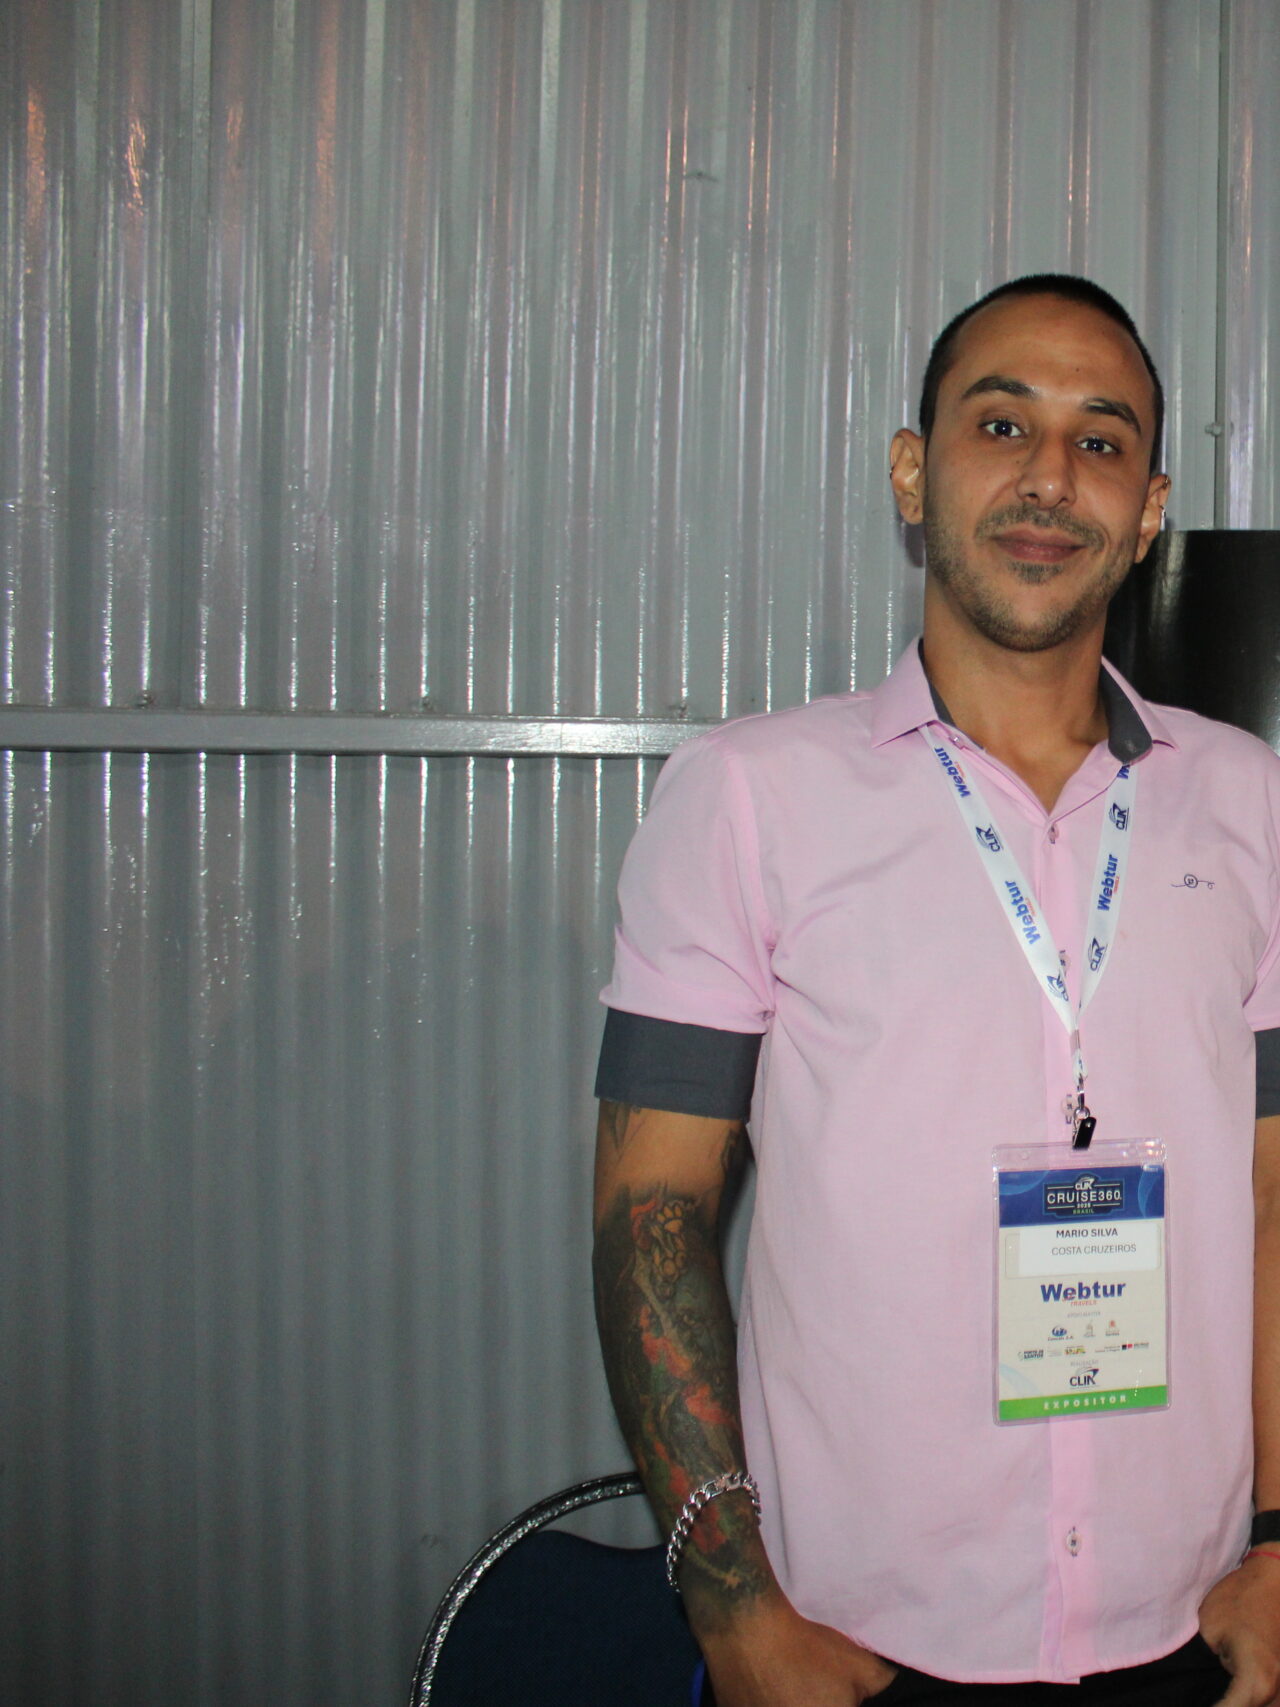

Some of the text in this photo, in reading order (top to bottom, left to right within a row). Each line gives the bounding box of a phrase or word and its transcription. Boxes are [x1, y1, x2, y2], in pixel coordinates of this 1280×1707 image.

[934, 747, 971, 798] Webtur
[1097, 853, 1119, 912] Webtur
[1005, 880, 1041, 945] Webtur
[1047, 1189, 1121, 1204] CRUISE360
[1056, 1227, 1118, 1239] MARIO SILVA
[1051, 1243, 1137, 1256] COSTA CRUZEIROS
[1040, 1281, 1126, 1303] Webtur
[1043, 1395, 1127, 1410] EXPOSITOR
